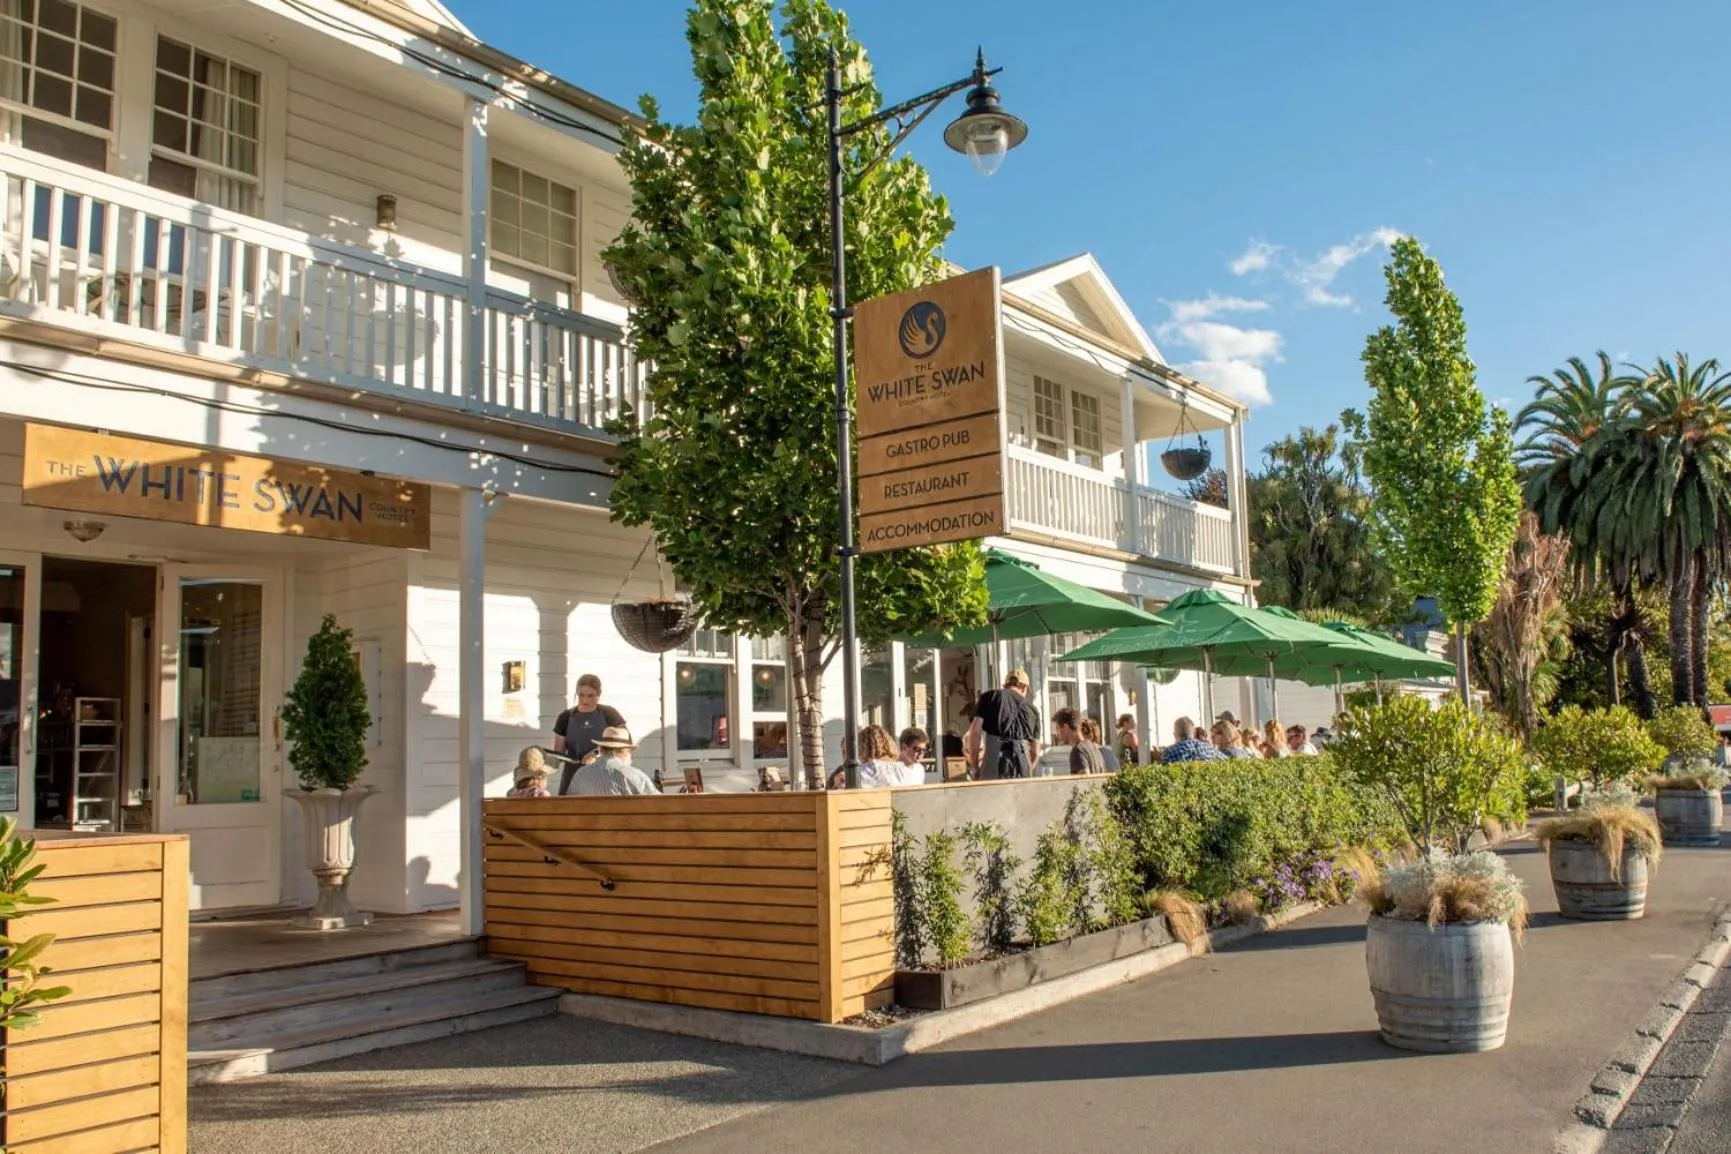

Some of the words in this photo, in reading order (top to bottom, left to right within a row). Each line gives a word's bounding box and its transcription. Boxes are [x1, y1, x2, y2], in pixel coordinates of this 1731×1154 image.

[867, 374, 926, 403] WHITE
[931, 360, 985, 390] SWAN
[914, 362, 933, 373] THE
[885, 435, 940, 458] GASTRO
[942, 430, 970, 448] PUB
[46, 460, 86, 477] THE
[93, 455, 240, 508] WHITE
[253, 478, 363, 524] SWAN
[884, 471, 970, 499] RESTAURANT
[867, 511, 995, 542] ACCOMMODATION
